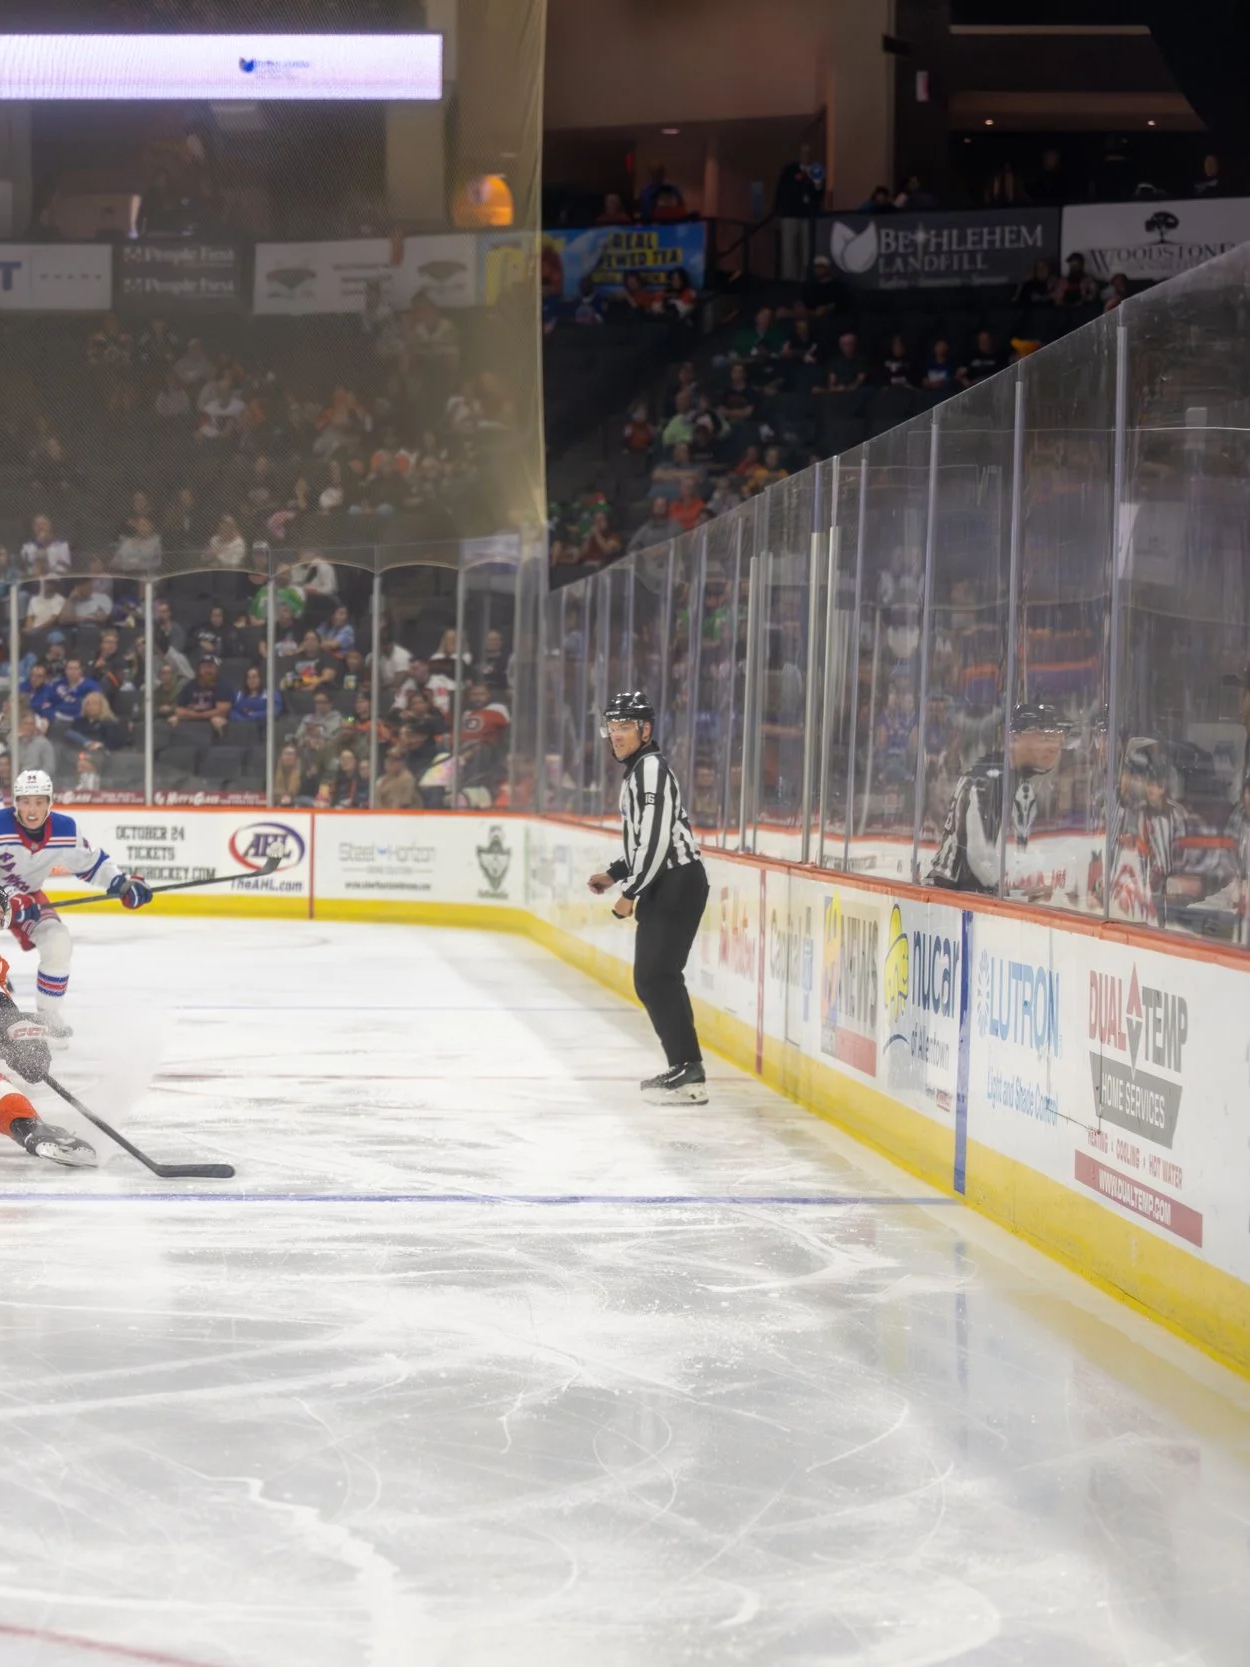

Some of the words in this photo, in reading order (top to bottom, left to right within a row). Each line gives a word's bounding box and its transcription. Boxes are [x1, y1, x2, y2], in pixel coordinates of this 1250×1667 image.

[879, 223, 1043, 254] BETHLEHEM
[879, 252, 988, 274] LANDFILL
[645, 793, 655, 804] 16
[116, 825, 167, 840] OCTOBER
[171, 825, 185, 840] 24
[127, 846, 175, 861] TICKETS
[243, 833, 293, 859] AHL
[912, 931, 959, 1018] nucar
[990, 957, 1059, 1058] LUTRON
[1089, 970, 1126, 1051] DUAL
[1142, 986, 1188, 1073] TEMP
[918, 1025, 949, 1070] Allentown
[987, 1066, 1002, 1109] Light
[1003, 1074, 1014, 1108] and
[1015, 1075, 1034, 1117] Shade
[1035, 1083, 1058, 1127] Control
[1101, 1073, 1123, 1111] HOME
[1125, 1080, 1166, 1130] SERVICES
[1088, 1129, 1108, 1154] HEATING
[1116, 1139, 1140, 1170] COOLING
[1149, 1153, 1160, 1177] HOT
[1162, 1157, 1183, 1190] WATER
[1099, 1168, 1171, 1226] WWW.DUALTEMP.COM
